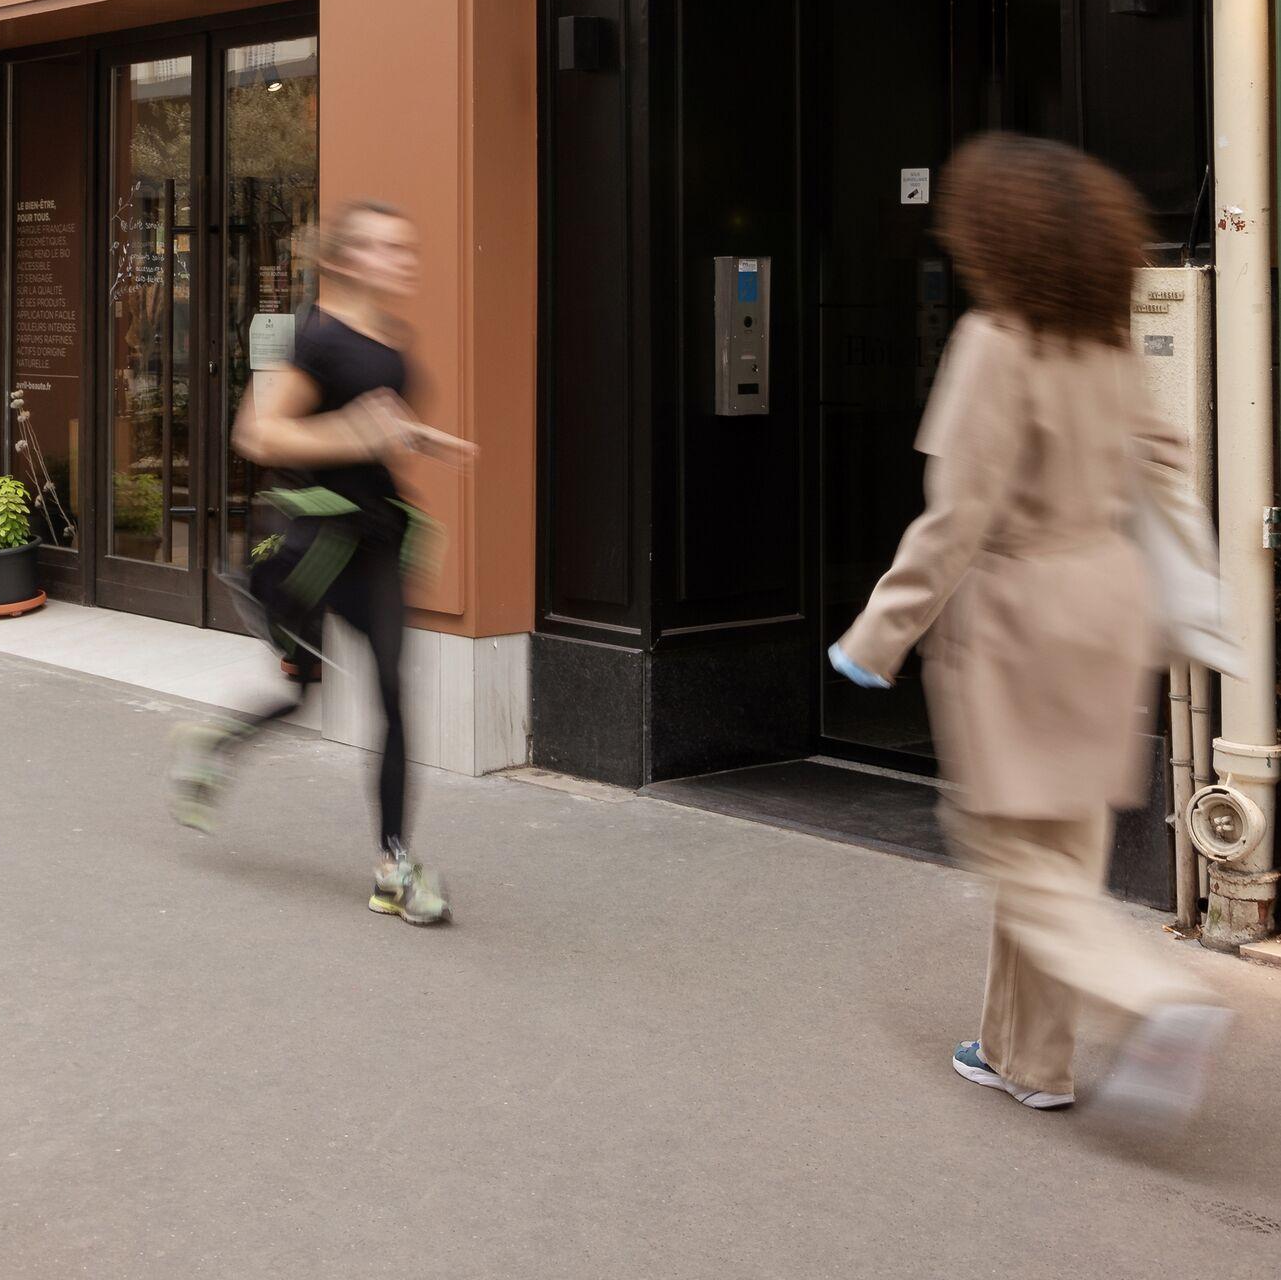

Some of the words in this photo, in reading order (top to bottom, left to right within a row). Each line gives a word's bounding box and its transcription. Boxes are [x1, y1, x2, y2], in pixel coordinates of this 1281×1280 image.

[17, 201, 24, 211] LE
[17, 213, 33, 223] POUR
[60, 248, 71, 258] BIO
